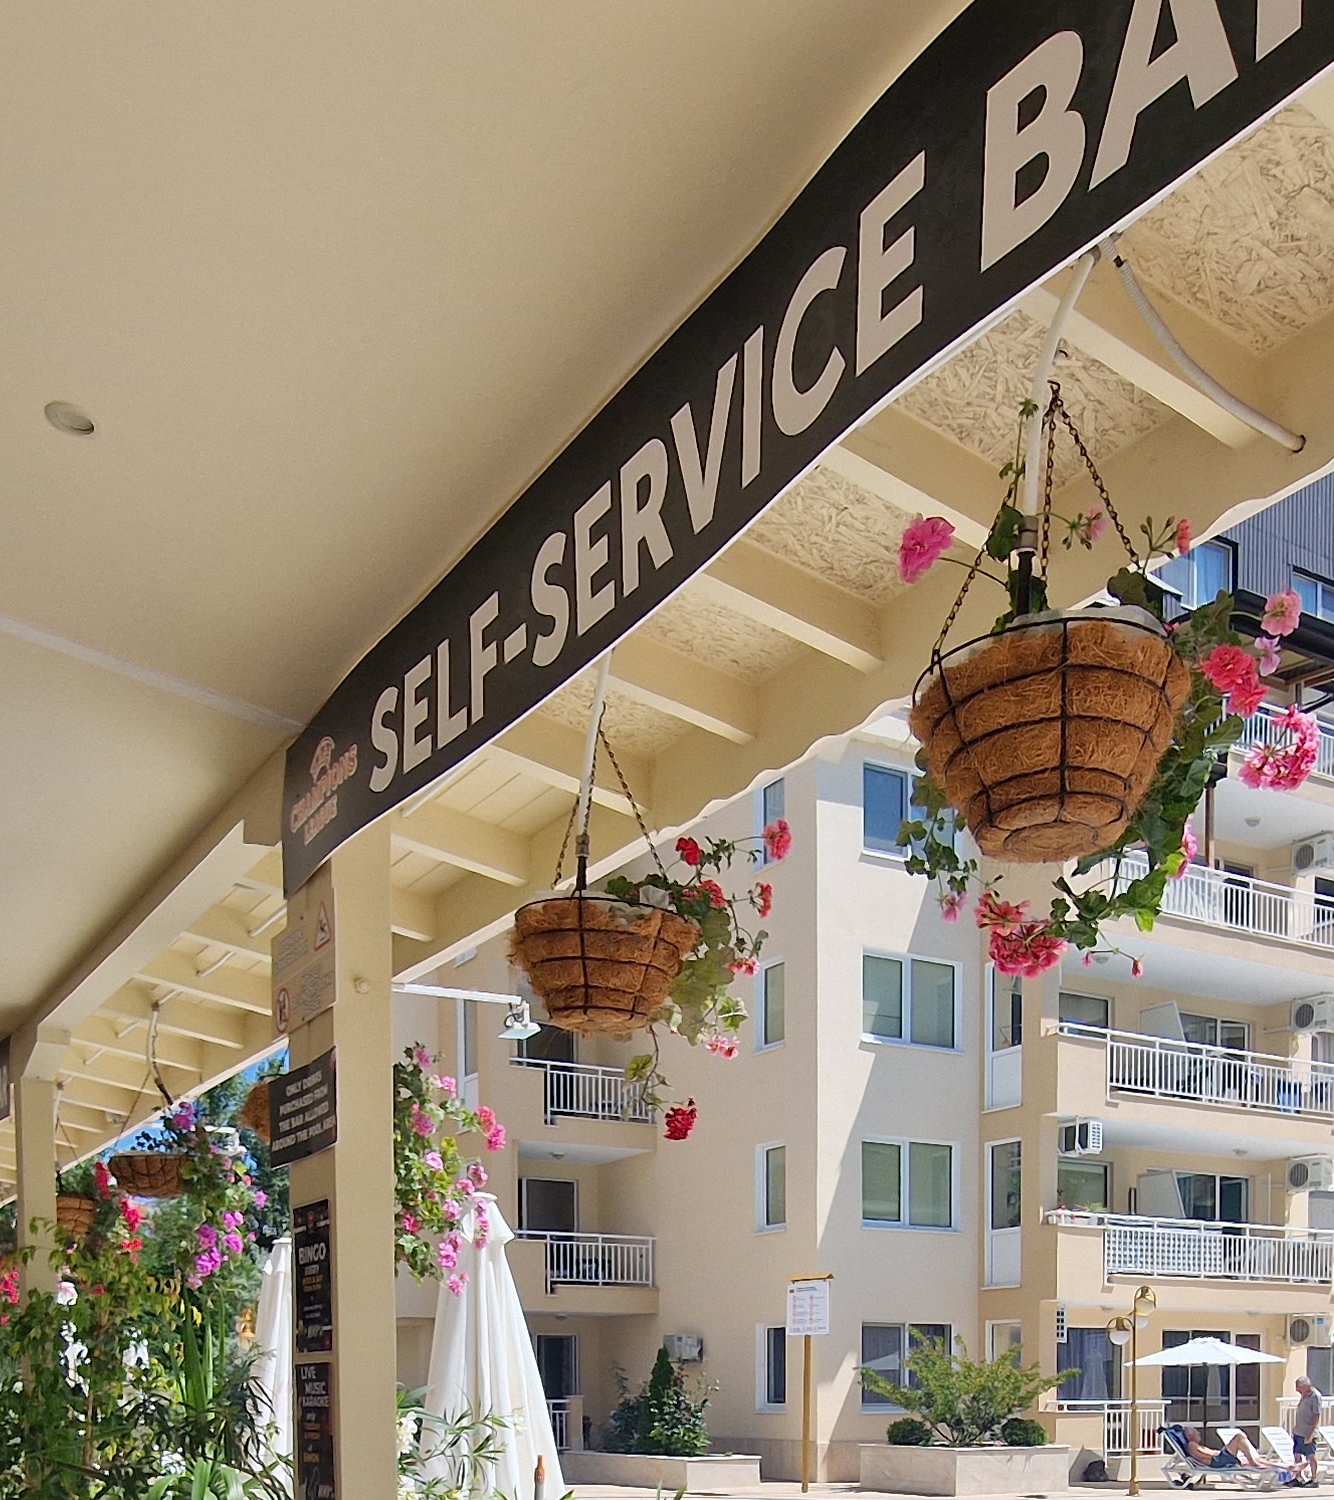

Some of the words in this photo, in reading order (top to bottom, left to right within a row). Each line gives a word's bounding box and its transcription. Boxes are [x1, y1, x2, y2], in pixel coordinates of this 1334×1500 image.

[369, 150, 925, 794] SELF-SERVICE
[980, 0, 1302, 273] BA
[298, 1242, 327, 1265] BINGO
[300, 1366, 317, 1380] LIVE
[304, 1381, 327, 1395] MUSIC
